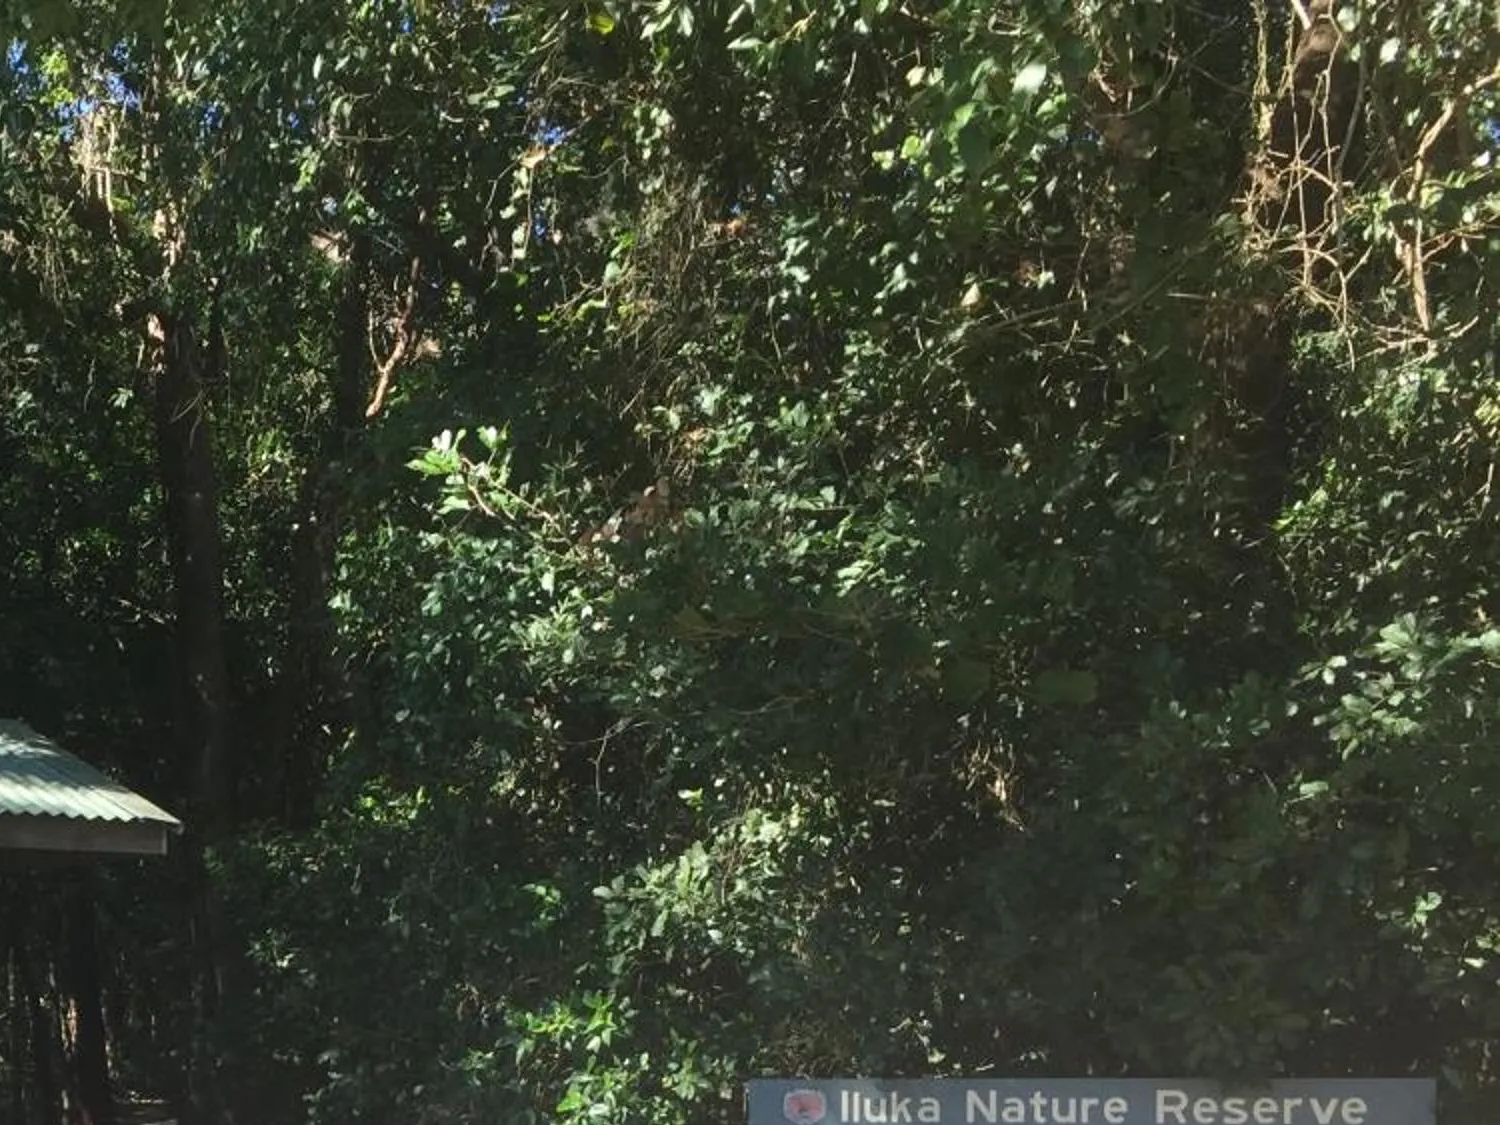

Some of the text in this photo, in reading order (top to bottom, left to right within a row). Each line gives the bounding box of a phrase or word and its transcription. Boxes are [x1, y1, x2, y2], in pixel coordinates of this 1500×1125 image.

[841, 1089, 1367, 1125] Iluka Nature Reserve
